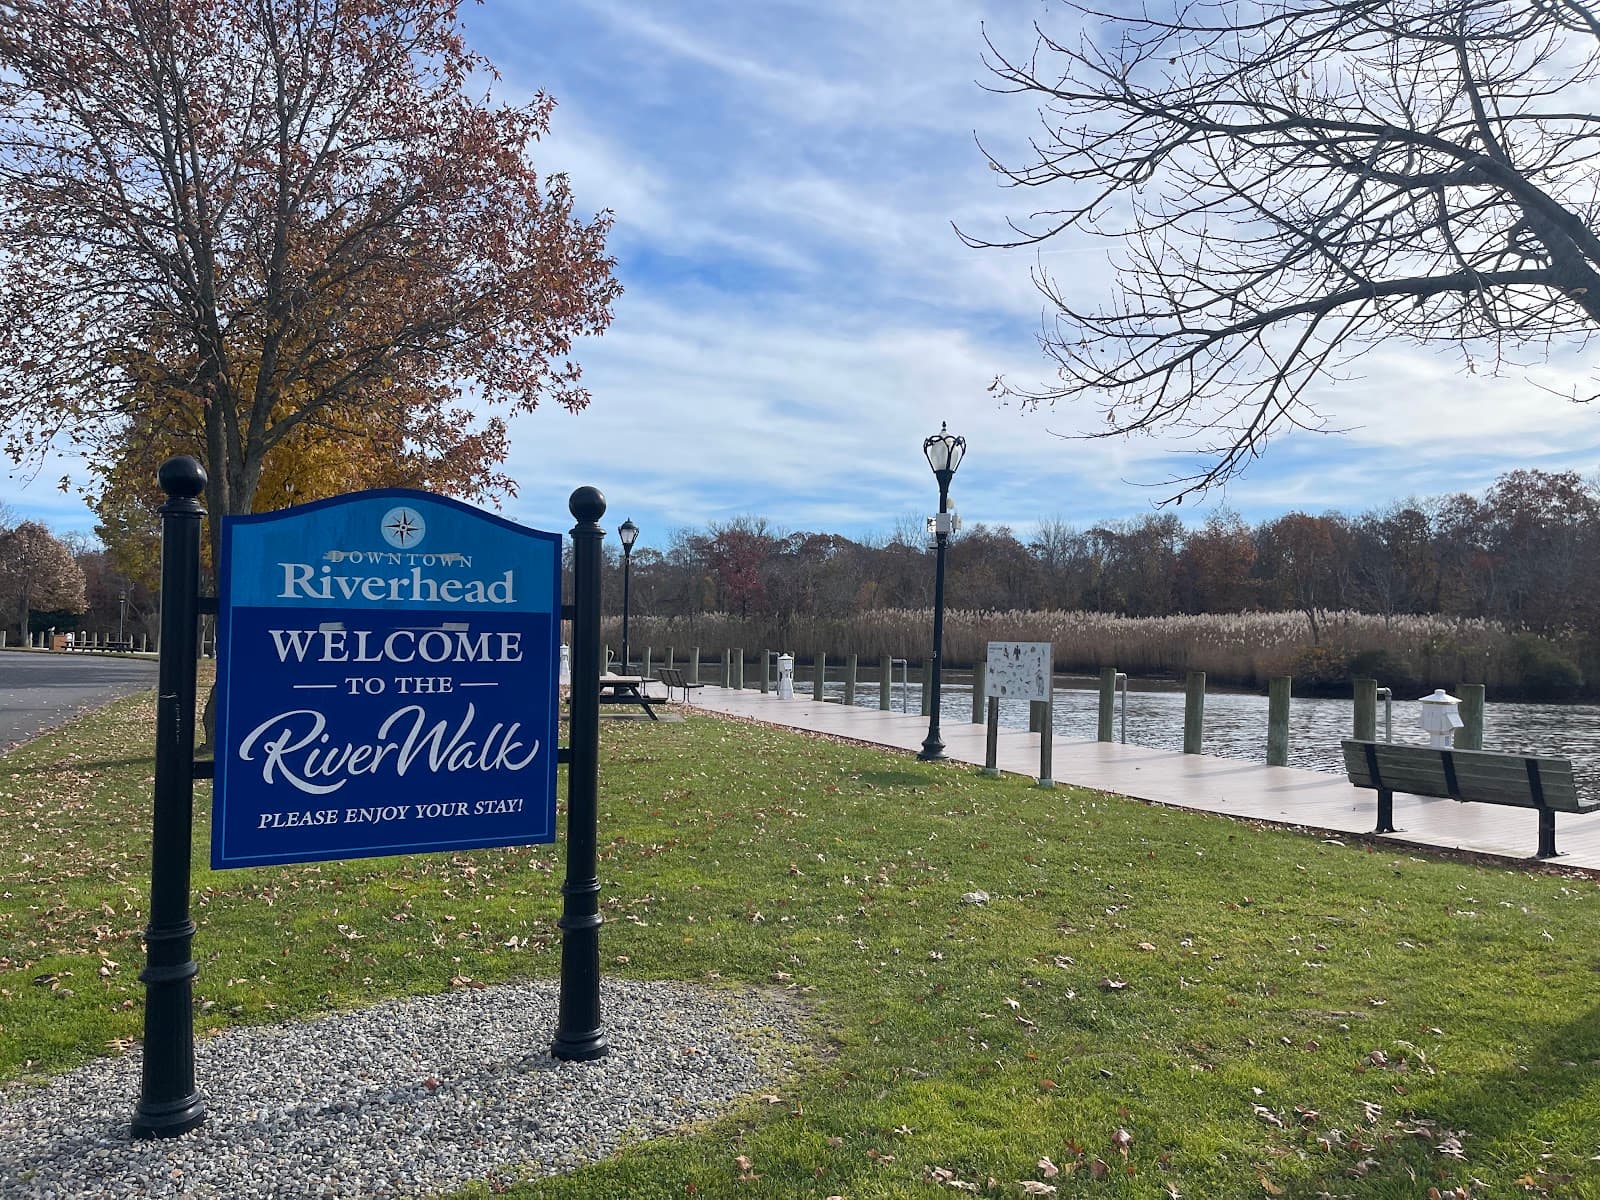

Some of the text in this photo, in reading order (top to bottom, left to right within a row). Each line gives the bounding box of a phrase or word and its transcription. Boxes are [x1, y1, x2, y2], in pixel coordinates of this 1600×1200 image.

[330, 550, 473, 569] DOWNTOWN
[276, 562, 517, 604] Riverhead
[268, 629, 523, 663] WELCOME
[344, 676, 454, 695] TO THE
[238, 701, 540, 795] RiverWalk
[257, 798, 524, 829] PLEASE ENJOY YOUR STAY!
